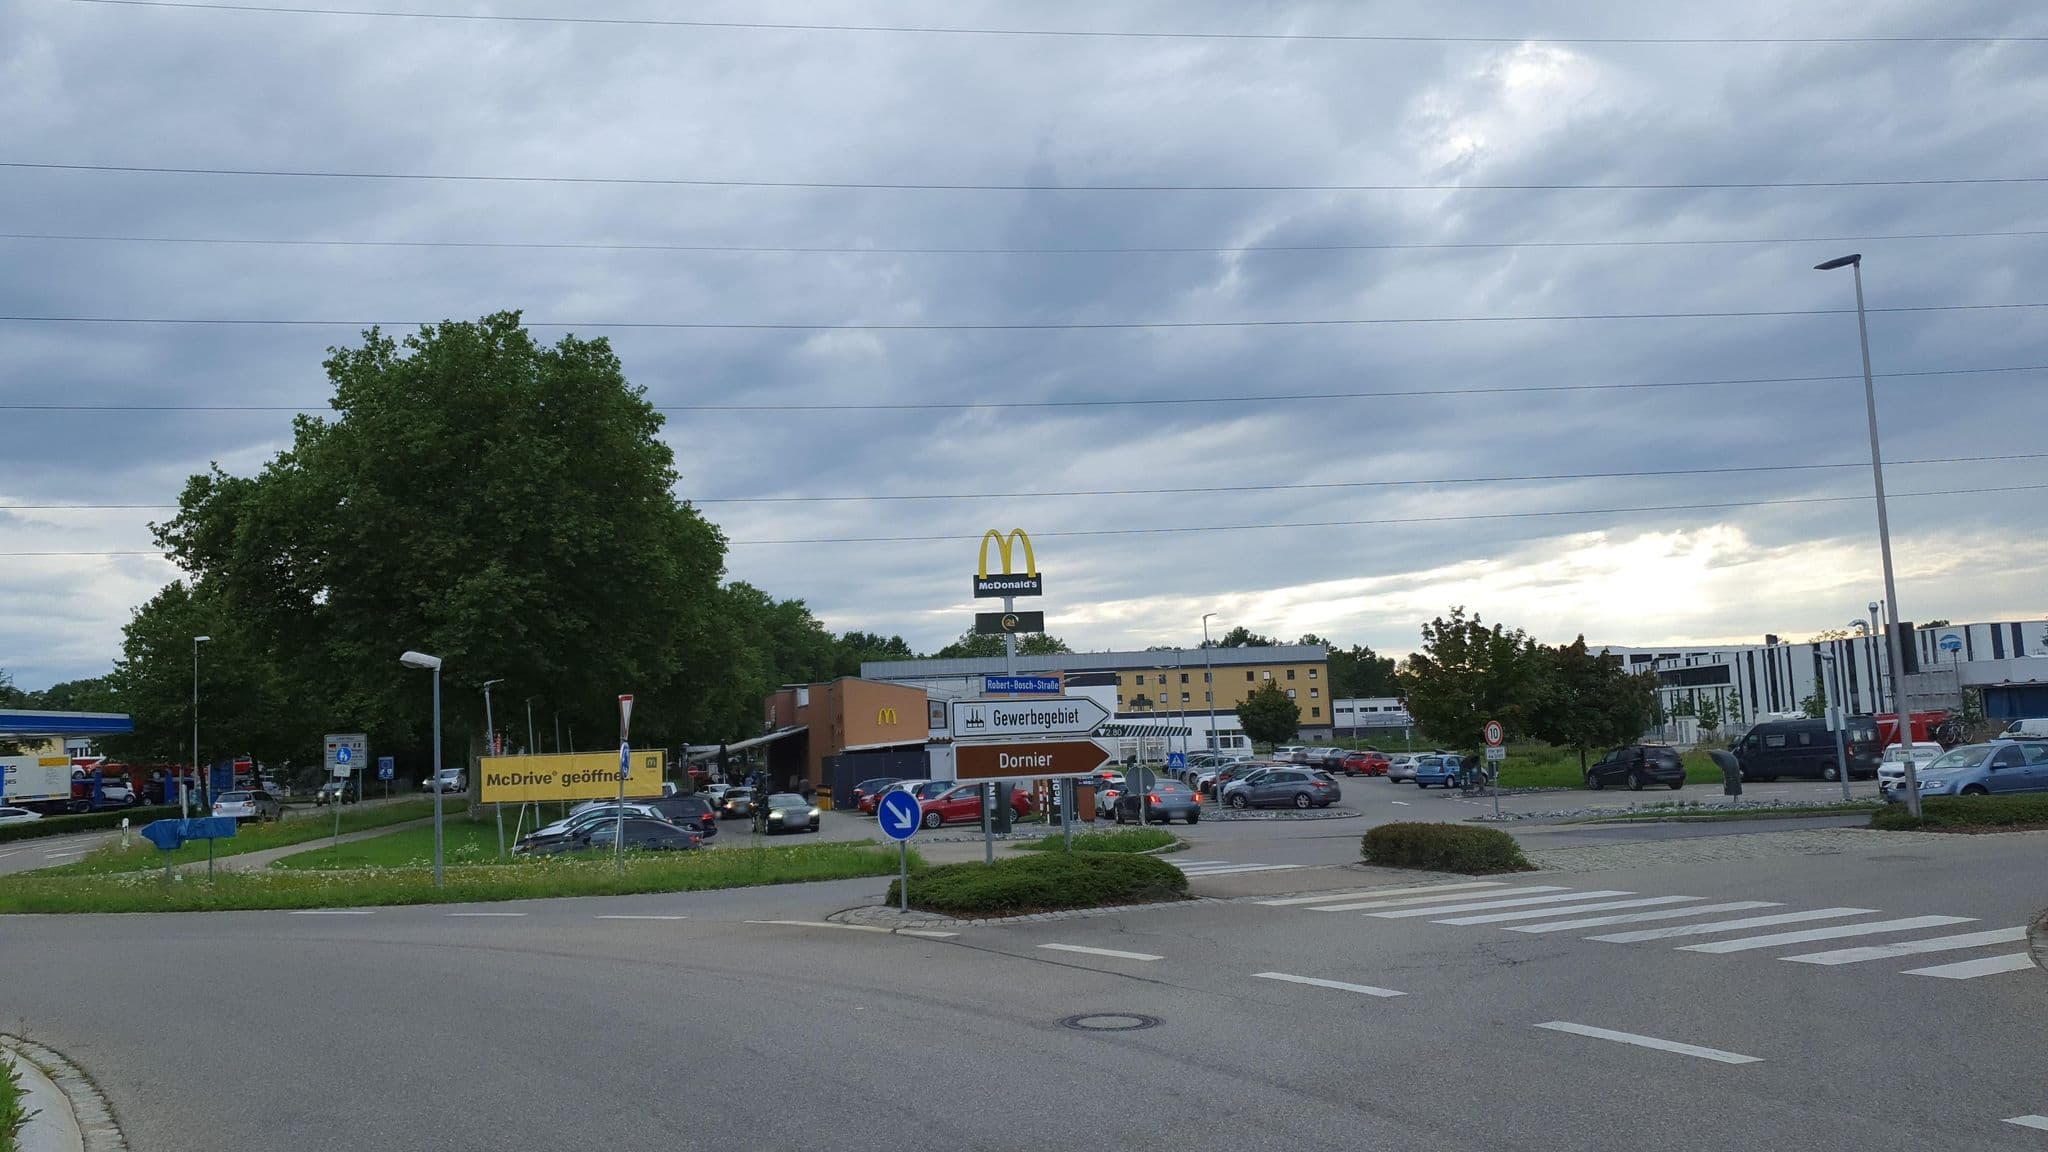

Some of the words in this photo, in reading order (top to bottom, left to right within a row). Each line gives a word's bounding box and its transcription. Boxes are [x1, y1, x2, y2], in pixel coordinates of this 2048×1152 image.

[978, 580, 1038, 590] McDonald's
[987, 679, 1059, 690] Robert-Bosch-Straße
[993, 707, 1079, 729] Gewerbegebiet
[1490, 728, 1498, 739] 10
[999, 751, 1053, 768] Dornier
